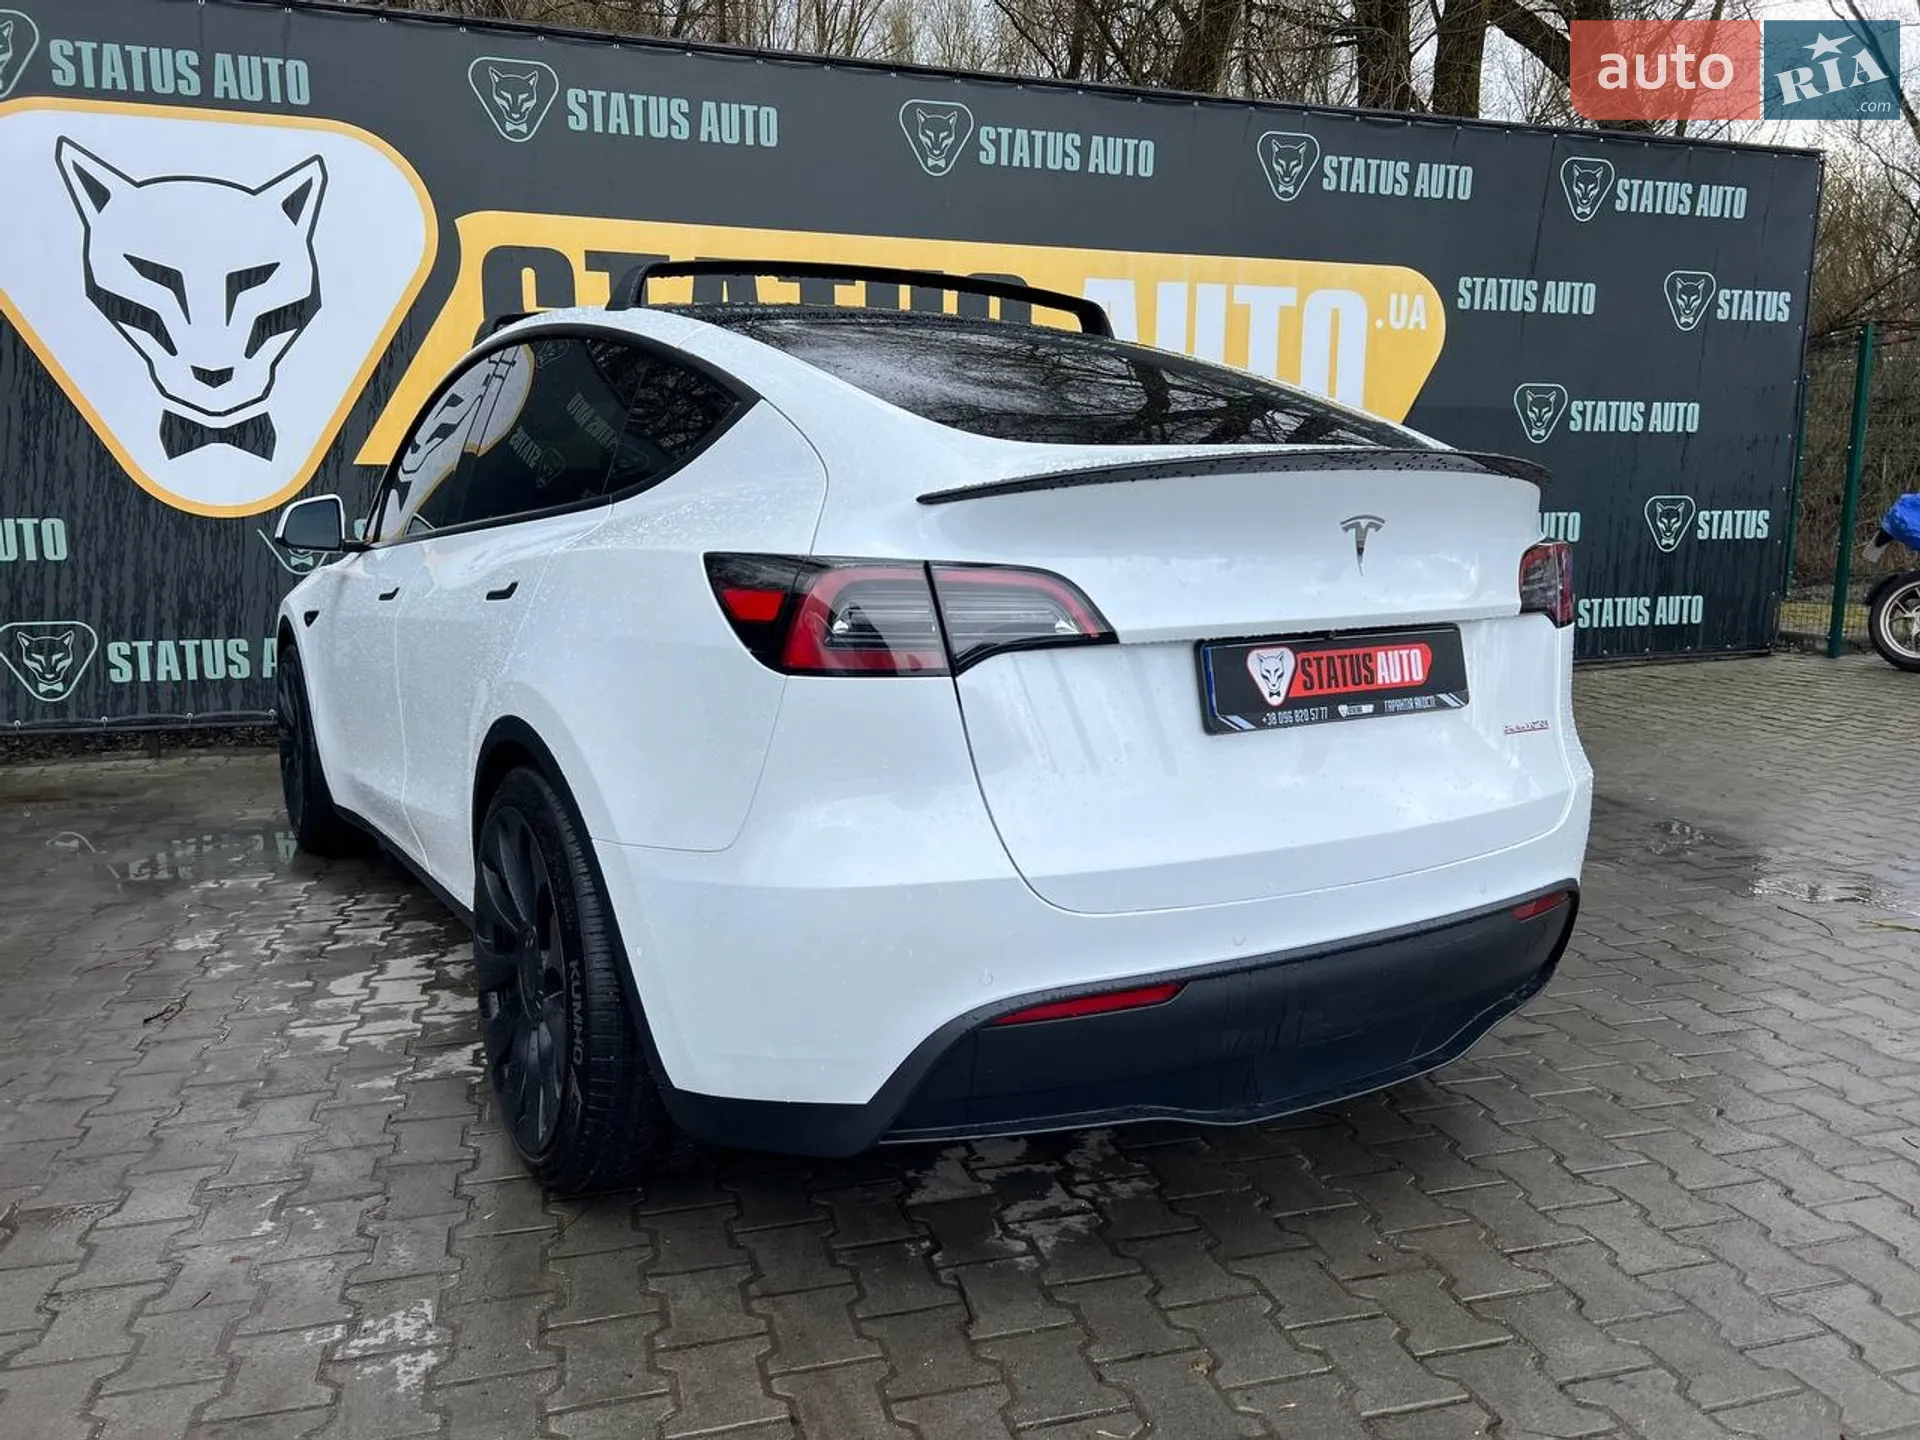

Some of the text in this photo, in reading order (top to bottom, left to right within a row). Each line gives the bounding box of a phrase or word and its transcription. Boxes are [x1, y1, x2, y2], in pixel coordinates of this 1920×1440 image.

[50, 39, 310, 105] STATUS AUTO
[567, 89, 778, 147] STATUS AUTO
[979, 125, 1155, 177] STATUS AUTO
[1323, 155, 1472, 200] STATUS AUTO
[1615, 179, 1747, 219] STATUS AUTO
[1457, 277, 1596, 315] STATUS AUTO
[1717, 289, 1790, 322] STATUS
[1569, 400, 1700, 433] STATUS AUTO
[0, 518, 67, 561] UTO
[1539, 512, 1580, 542] UTO
[1697, 510, 1770, 540] STATUS
[1577, 595, 1704, 629] STATUS AUTO
[108, 639, 250, 683] STATUS
[1301, 649, 1423, 691] STATUS AUTO
[569, 960, 584, 1065] KUMHO
